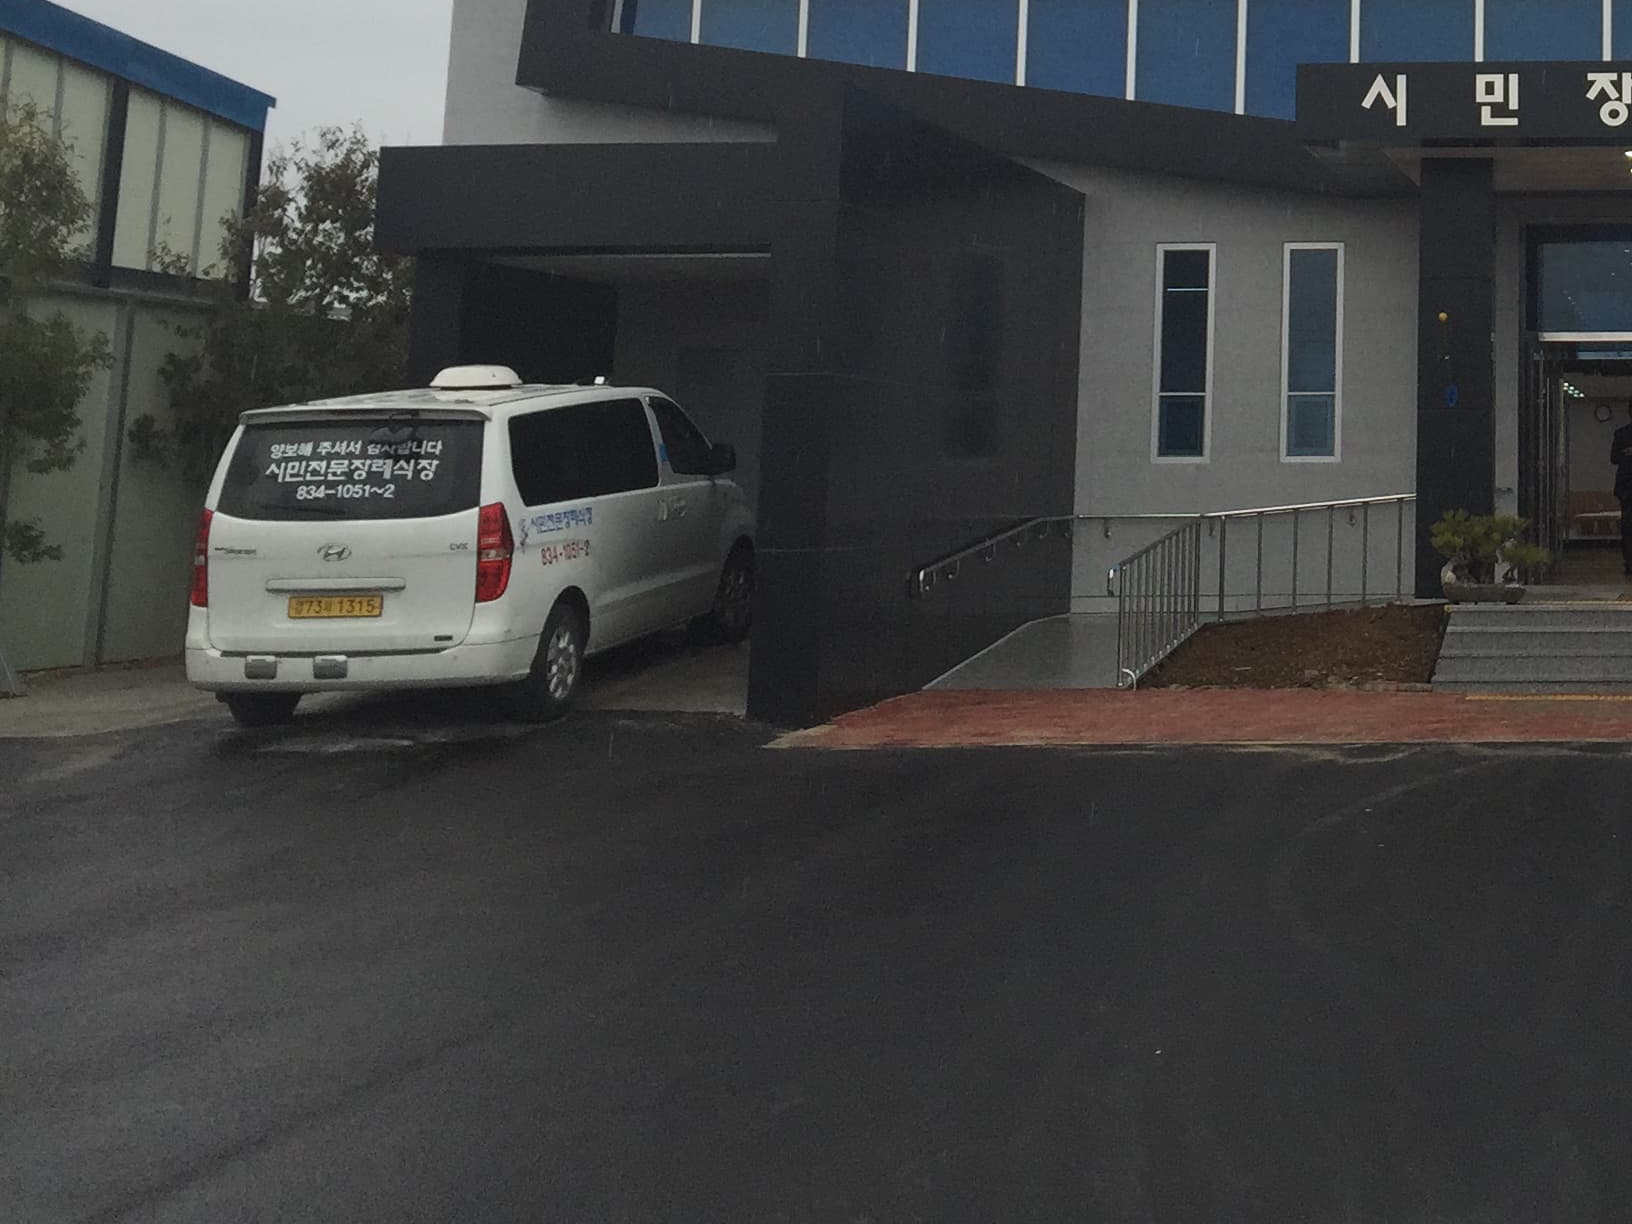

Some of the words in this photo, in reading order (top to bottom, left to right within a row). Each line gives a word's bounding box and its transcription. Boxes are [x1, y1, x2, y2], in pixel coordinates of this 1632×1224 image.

[270, 441, 314, 459] 양보해
[316, 440, 363, 456] 주셔서
[265, 458, 441, 483] 시민전문장례식장
[336, 598, 376, 615] 1315
